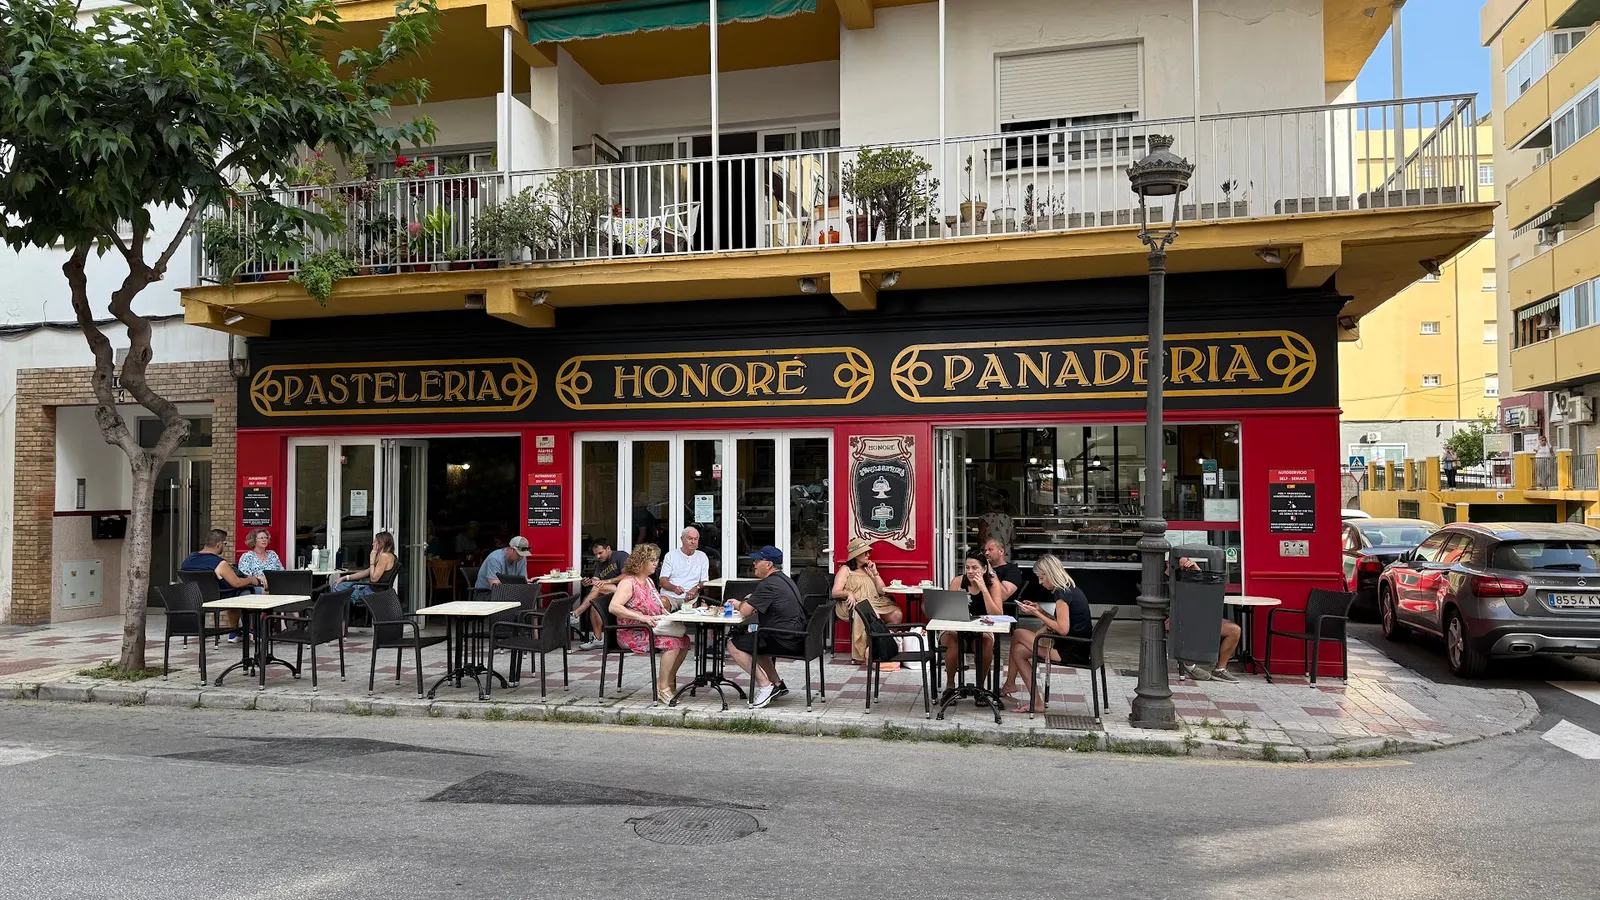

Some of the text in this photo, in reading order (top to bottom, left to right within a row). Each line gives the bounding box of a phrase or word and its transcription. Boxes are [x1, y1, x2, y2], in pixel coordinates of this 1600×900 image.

[614, 354, 808, 399] HONORÉ
[943, 344, 1263, 391] PANADERIA
[283, 370, 502, 406] PASTELERIA
[1556, 595, 1584, 605] 8554
